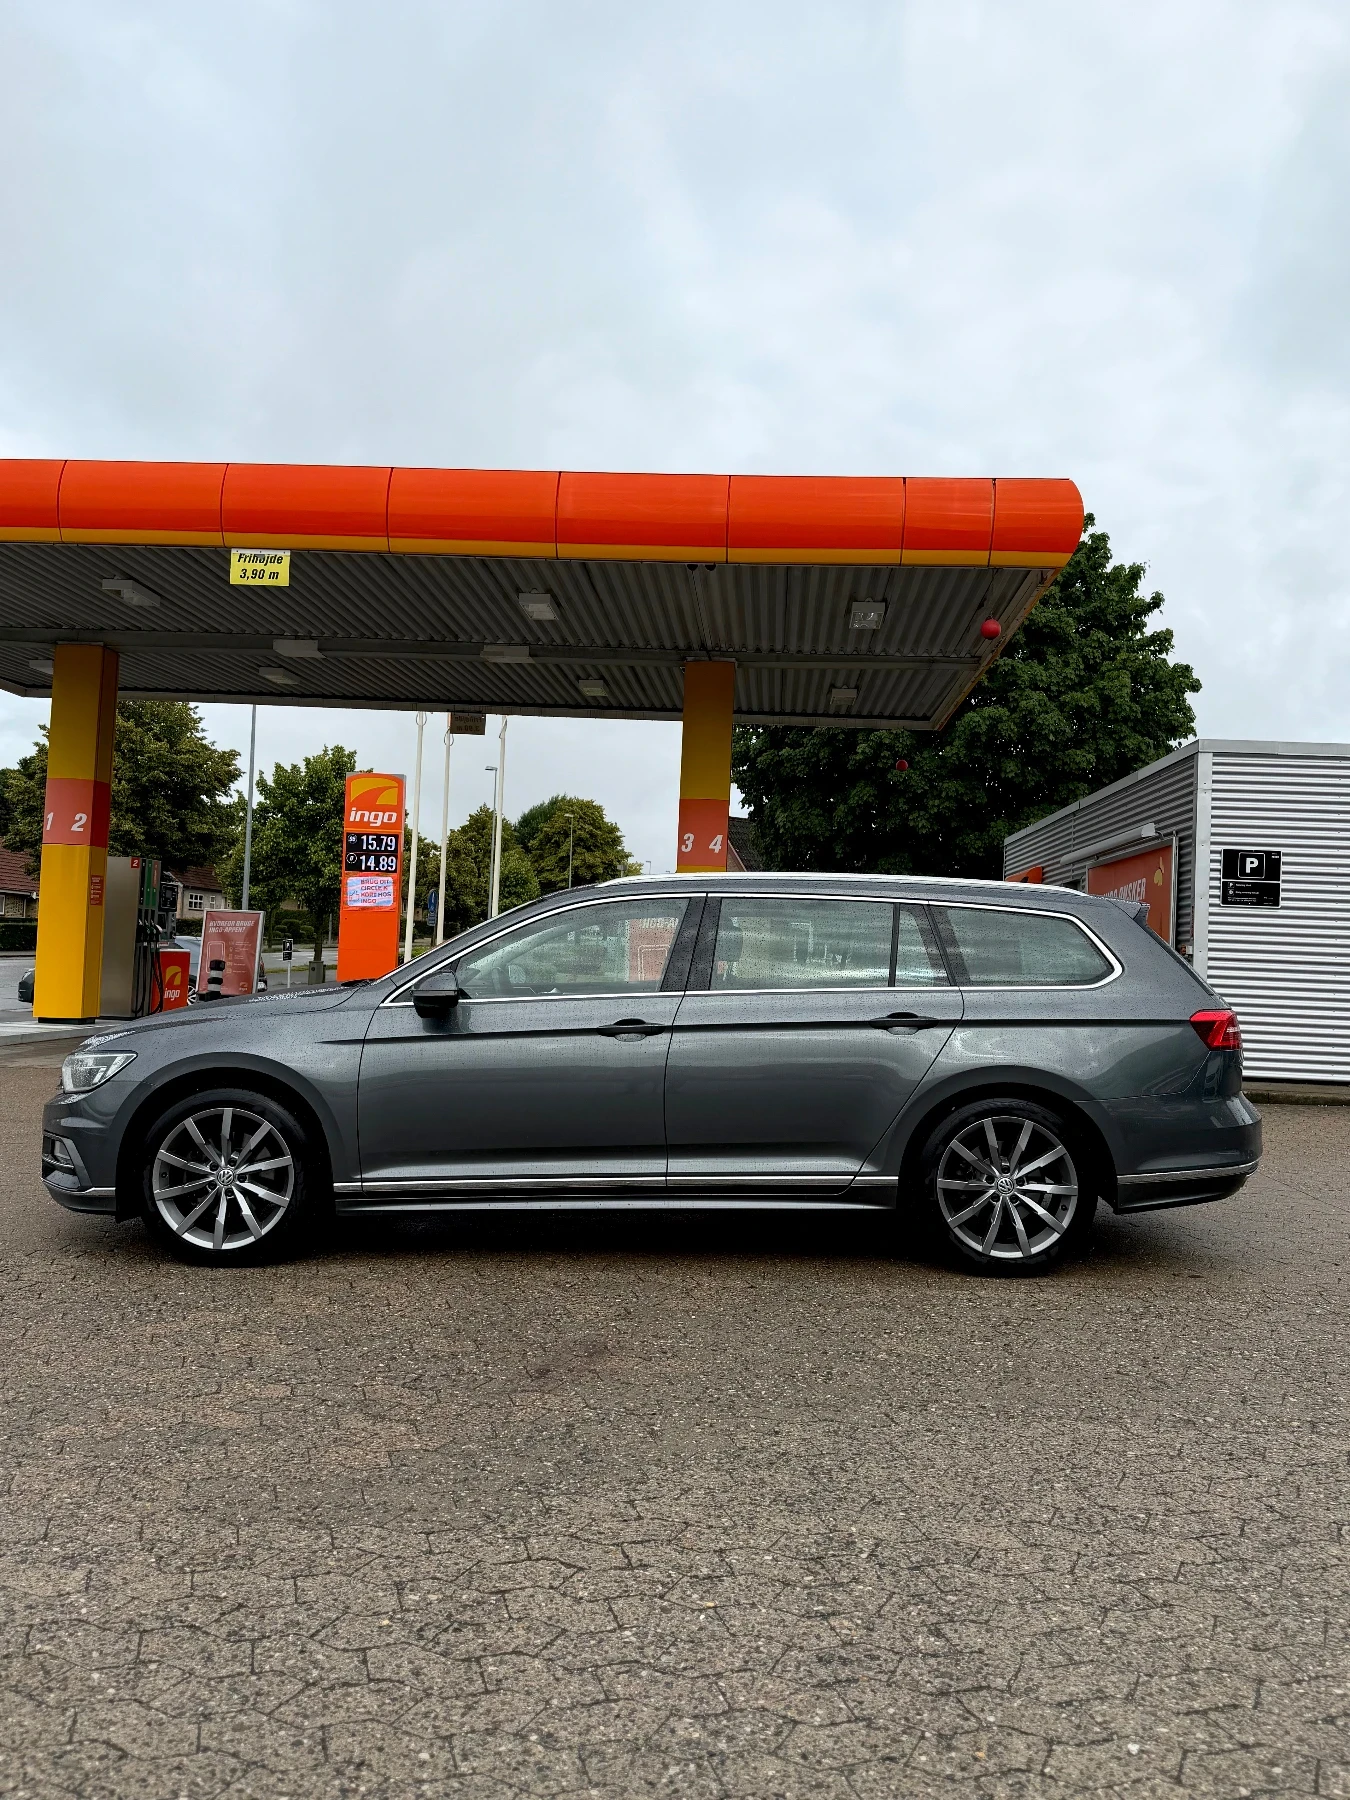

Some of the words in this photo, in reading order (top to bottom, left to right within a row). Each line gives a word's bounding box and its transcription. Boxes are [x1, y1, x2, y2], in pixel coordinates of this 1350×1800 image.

[240, 568, 266, 581] 3,90
[268, 571, 280, 580] m
[45, 812, 54, 831] 1
[70, 813, 88, 832] 2
[349, 806, 398, 827] ingo
[360, 834, 396, 851] 15.79
[681, 832, 695, 853] 3
[708, 834, 724, 854] 4
[132, 859, 139, 867] 2
[359, 854, 397, 871] 14.89
[1245, 857, 1259, 874] P
[164, 987, 181, 1001] ingo
